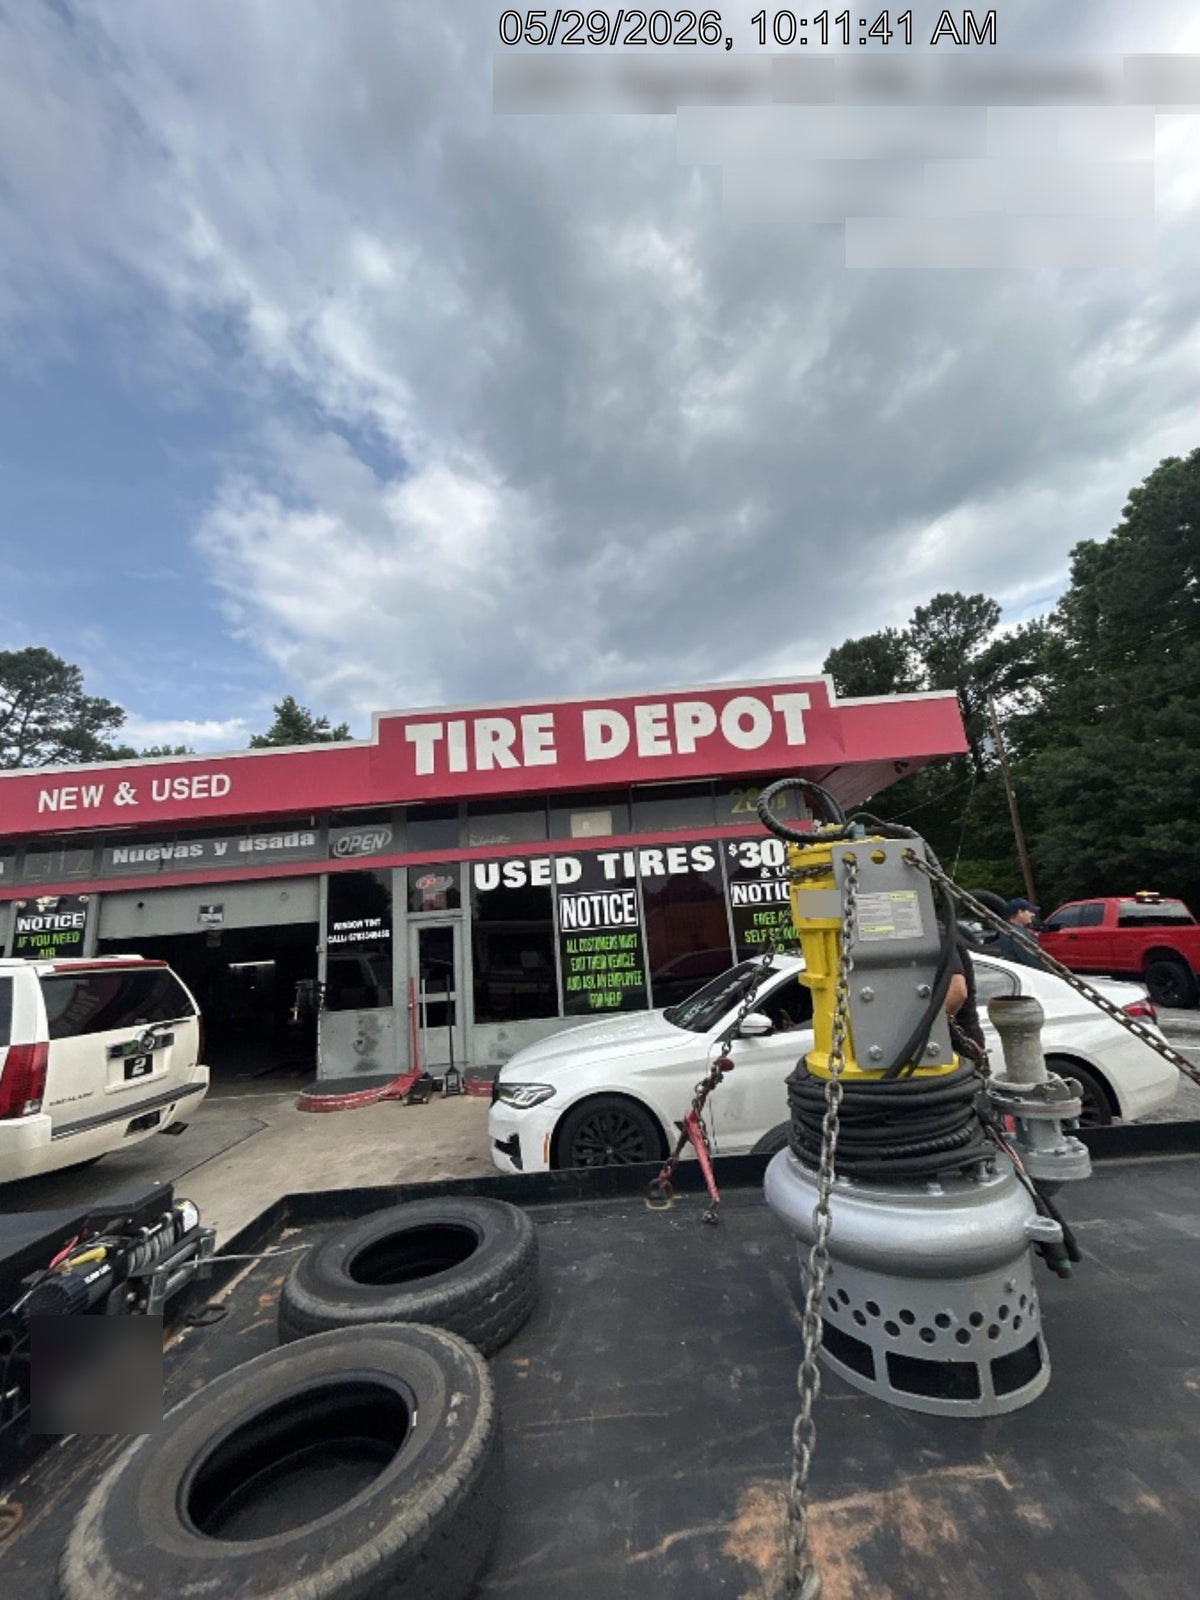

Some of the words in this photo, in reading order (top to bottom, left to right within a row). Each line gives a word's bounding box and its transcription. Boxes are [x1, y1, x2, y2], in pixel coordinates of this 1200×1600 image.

[405, 712, 557, 776] TIRE
[582, 692, 810, 762] DEPOT
[38, 784, 104, 813] NEW
[113, 781, 139, 806] &
[152, 774, 231, 802] USED
[113, 844, 203, 864] Nuevas
[214, 842, 228, 856] y
[238, 832, 315, 852] usada
[337, 833, 386, 853] OPEN
[474, 855, 583, 891] USED
[597, 845, 717, 880] TIRES
[761, 867, 771, 878] &
[732, 882, 791, 904] NOTIC
[561, 892, 636, 929] NOTICE
[753, 912, 777, 926] FREE
[16, 912, 85, 931] NOTICE
[17, 936, 29, 949] IF
[30, 933, 50, 947] YOU
[52, 931, 80, 945] NEED
[744, 929, 767, 943] SELF
[39, 946, 56, 958] AIR
[132, 1053, 147, 1076] 2
